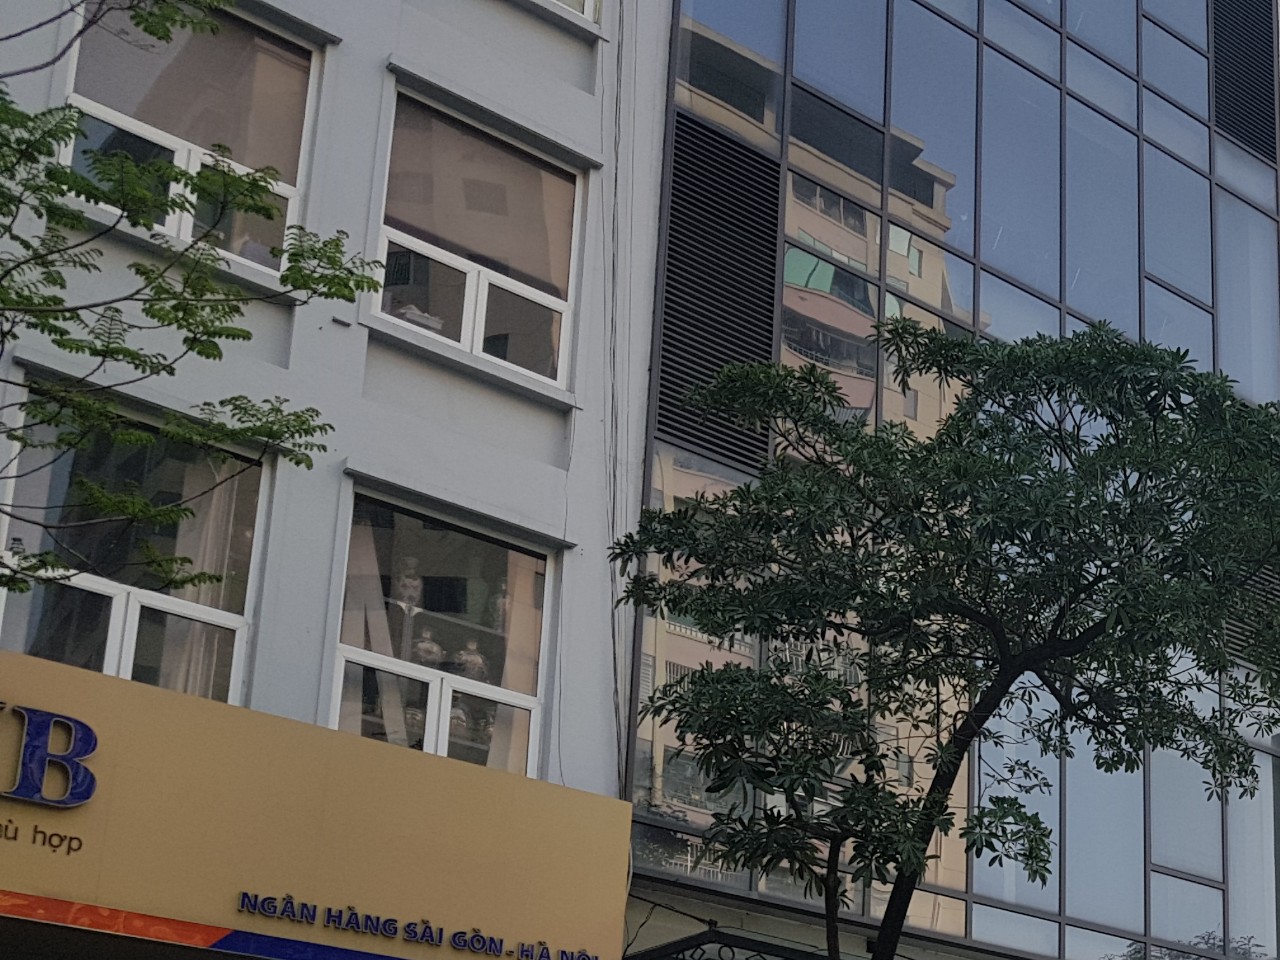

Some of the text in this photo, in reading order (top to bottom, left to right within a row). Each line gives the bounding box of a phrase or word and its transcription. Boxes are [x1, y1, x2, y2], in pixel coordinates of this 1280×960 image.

[0, 704, 98, 808] B
[32, 825, 83, 853] hợp
[238, 891, 316, 924] NGÂN
[324, 906, 397, 939] HÀNG
[403, 918, 444, 947] SÀI
